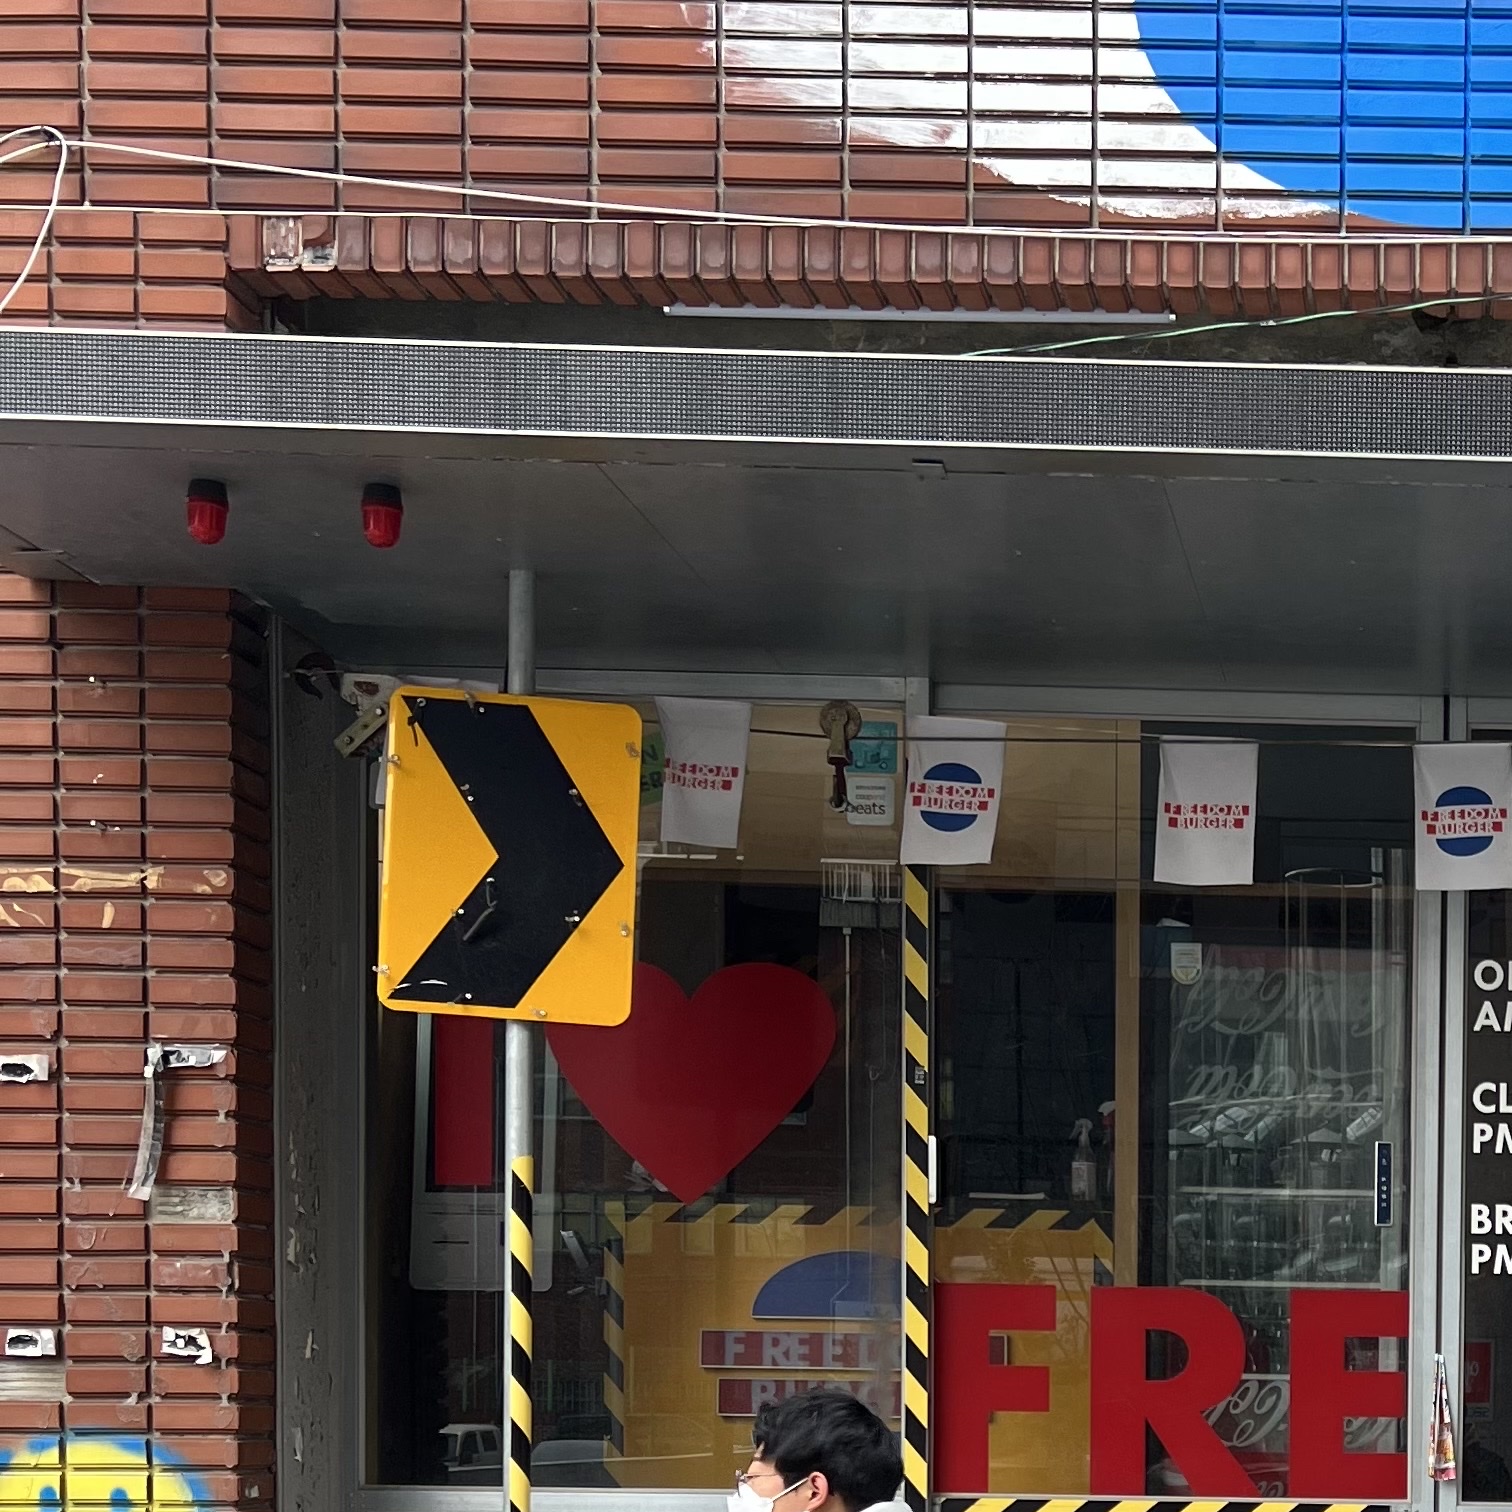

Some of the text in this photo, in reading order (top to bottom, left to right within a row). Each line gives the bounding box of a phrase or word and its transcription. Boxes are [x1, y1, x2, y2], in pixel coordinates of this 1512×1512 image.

[914, 783, 989, 799] FREEDOM
[921, 797, 980, 812] BURGER
[1170, 803, 1243, 815] FREEDOM
[1427, 808, 1501, 822] FREEDOM
[1177, 817, 1236, 829] BURGER
[1435, 821, 1494, 836] BURGER
